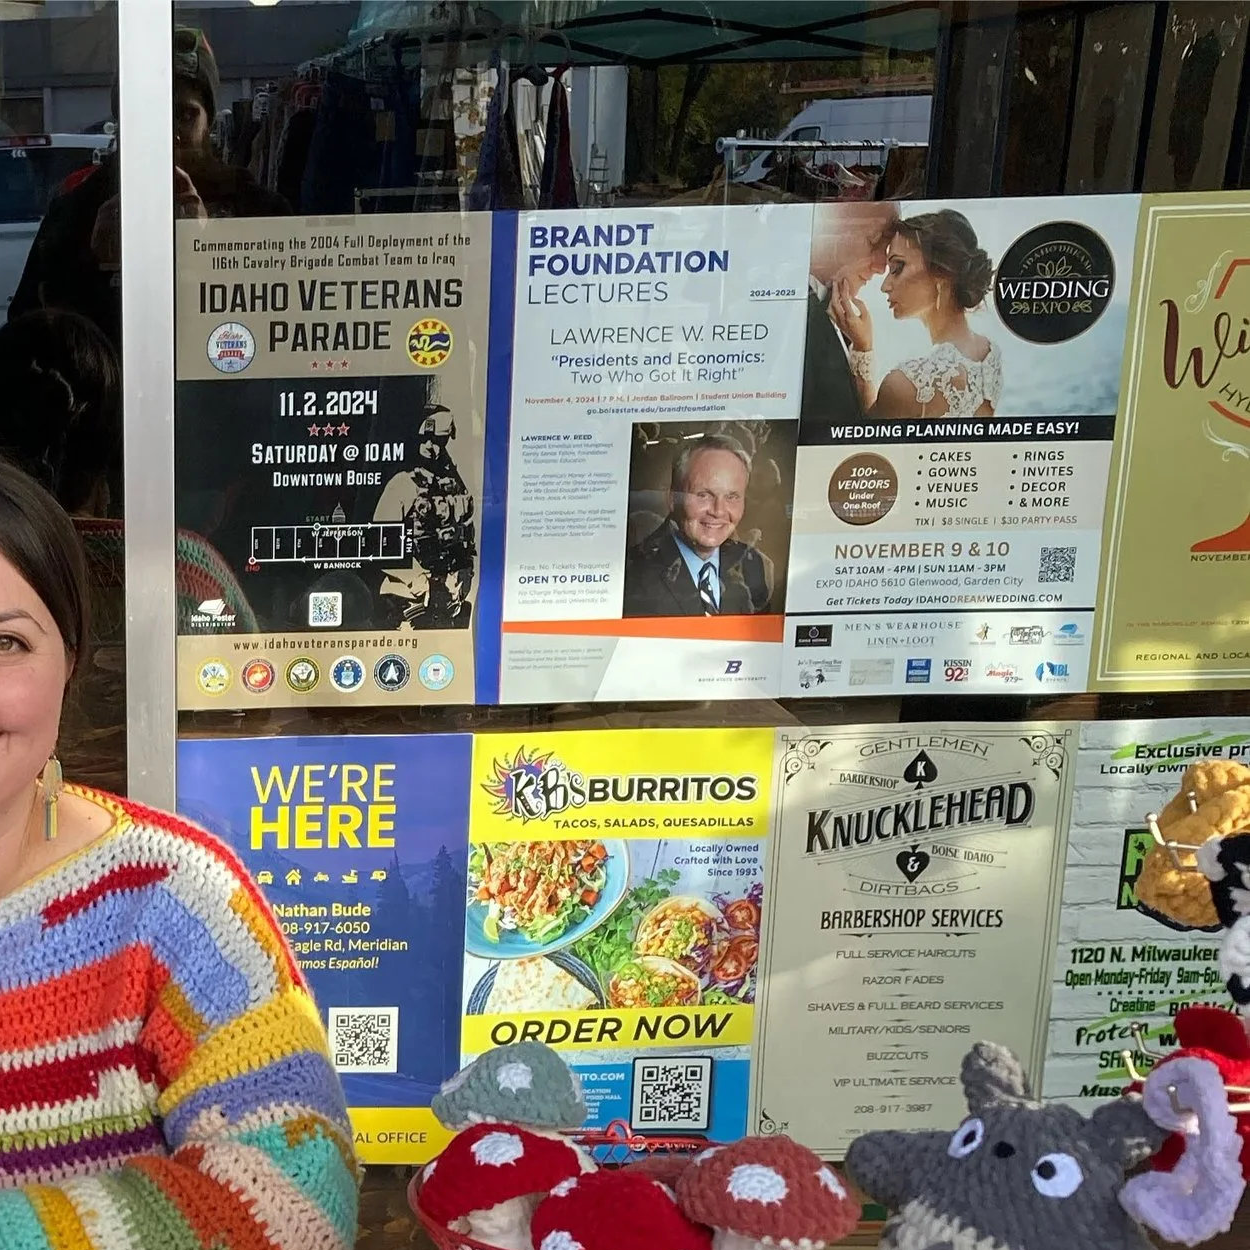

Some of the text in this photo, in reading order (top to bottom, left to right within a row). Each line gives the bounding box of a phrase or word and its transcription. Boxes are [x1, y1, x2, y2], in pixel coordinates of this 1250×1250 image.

[530, 224, 654, 248] BRANDT
[194, 234, 470, 252] Commemorating the 2004 Full Deployment the
[212, 253, 455, 271] 116th Cavalry Brigade Combat Team Iraq
[529, 251, 729, 276] FOUNDATION
[200, 278, 462, 313] IDAHO VETERANS
[529, 282, 668, 304] LECTURES
[999, 280, 1109, 299] WEDDING
[1033, 301, 1071, 314] EXPO
[269, 321, 391, 352] PARADE
[551, 324, 769, 345] LAWRENCE W. REED
[644, 351, 765, 366] and Economics:
[571, 369, 675, 384] Two Who Got
[280, 390, 378, 416] 11.2.2024
[831, 422, 1079, 439] WEDDING PLANNING MADE EASY!
[252, 444, 358, 464] SATURDAY @
[930, 452, 971, 462] CAKES
[1024, 451, 1064, 461] RINGS
[273, 470, 382, 487] DOWNTOWN BOISE
[851, 467, 878, 477] 100+
[928, 468, 977, 478] GOWNS
[1023, 467, 1073, 477] INVITES
[838, 480, 890, 489] VENDORS
[927, 483, 978, 493] VENUES
[1021, 482, 1066, 492] DECOR
[849, 492, 874, 500] Under
[1032, 497, 1069, 507] MORE
[861, 501, 881, 509] Roof
[926, 498, 968, 509] MUSIC
[955, 516, 1077, 525] SINGLE $30 PARTY PASS
[835, 542, 1009, 559] NOVEMBER 9 & 10
[835, 564, 1006, 574] SAT 10AM 4PM SUN 11AM 3PM
[519, 574, 610, 585] OPEN TO PUBLIC
[816, 576, 1023, 588] EXPO IDAHO 5610 Glenwood, Garden City
[826, 594, 1062, 607] Get Tickets Today IDAHODREAMWEDDING.COM
[234, 637, 418, 650] www.idahoveteransparade.org
[1136, 652, 1218, 661] REGIONAL AND
[860, 737, 989, 756] GENTLEMEN
[1135, 744, 1222, 759] Exclusive
[1101, 764, 1153, 775] Locally
[251, 764, 396, 803] WE'RE
[839, 773, 899, 789] BARBERSHOP
[588, 776, 756, 802] BURRITOS
[554, 817, 754, 829] TACOS, SALADS, QUESADILLAS
[806, 782, 1034, 854] KNUCKLEHEAD
[251, 805, 396, 849] HERE
[690, 844, 759, 855] Locally Owned
[931, 845, 994, 864] BOISE IDAHO
[713, 856, 733, 864] with
[708, 867, 757, 876] Since 1993
[860, 881, 959, 895] DIRTBAGS
[273, 903, 371, 917] Nathan Bude
[821, 909, 1003, 929] BARBERSHOP SERVICES
[325, 939, 407, 952] Rd, Meridian
[836, 950, 976, 959] FULL SERVICE HAIRCUTS
[1071, 948, 1104, 964] 1120
[329, 957, 380, 971] Español!
[862, 976, 944, 985] RAZOR FADES
[1065, 967, 1172, 989] Open Monday-Friday
[808, 1001, 1003, 1012] SHAVES FULL BEARD SERVICES
[1110, 998, 1155, 1012] Creatine
[491, 1012, 733, 1045] ORDER NOW
[829, 1025, 970, 1035] MILITARY/KIDS/SENIORS
[867, 1052, 928, 1061] BUZZCUTS
[834, 1077, 956, 1087] VIP ULTIMATE SERVICE
[854, 1104, 932, 1113] 208-917-3987
[377, 1132, 427, 1143] OFFICE
